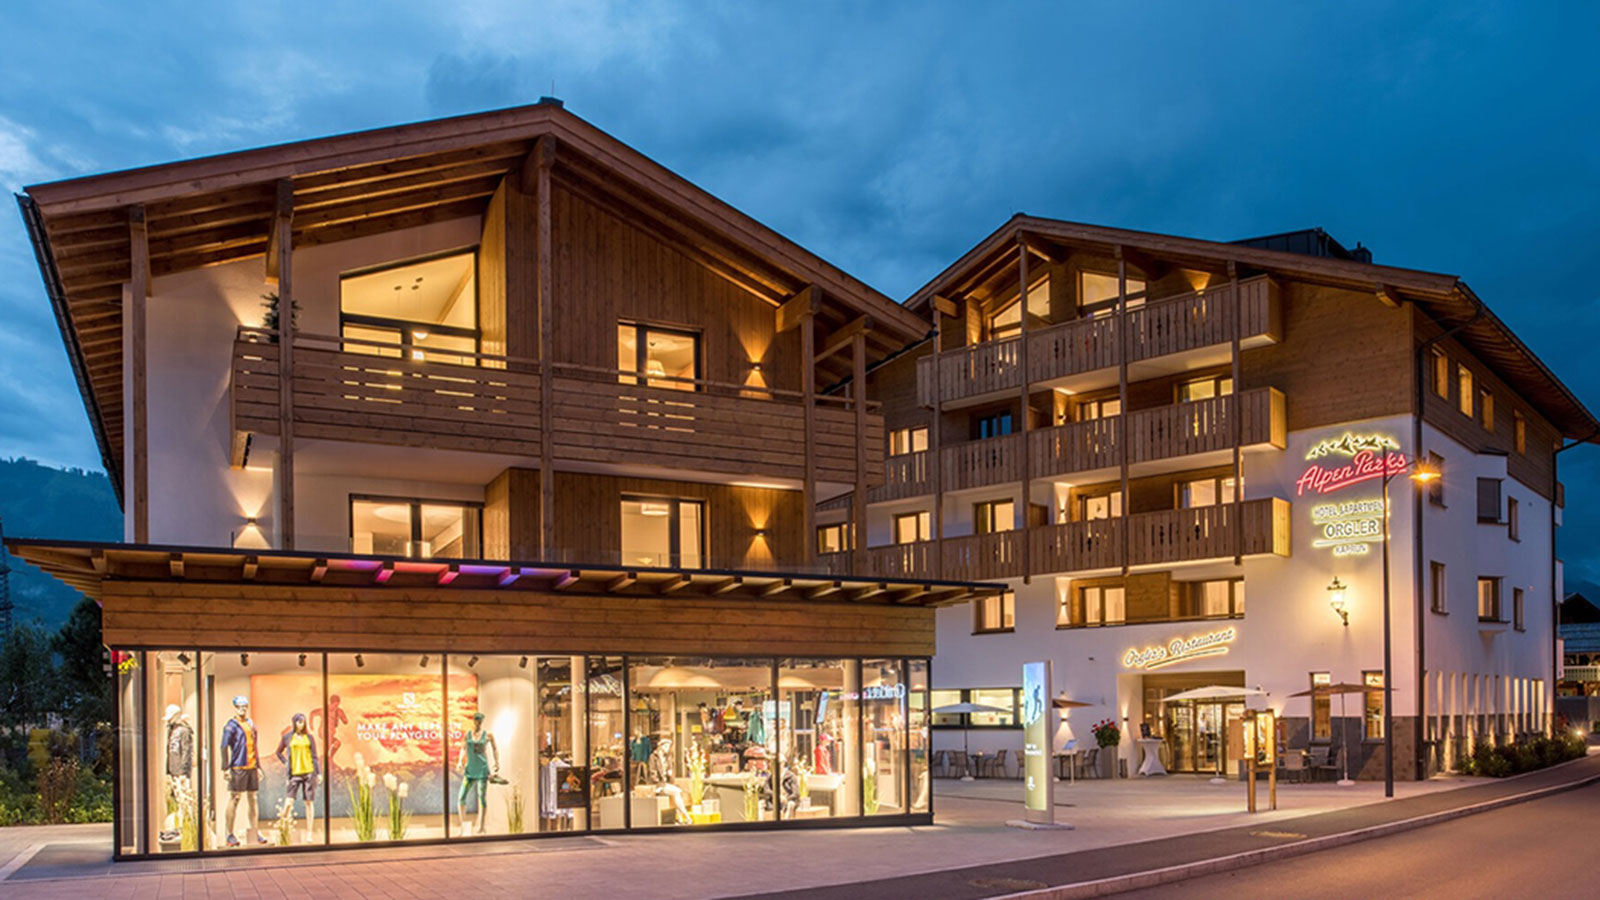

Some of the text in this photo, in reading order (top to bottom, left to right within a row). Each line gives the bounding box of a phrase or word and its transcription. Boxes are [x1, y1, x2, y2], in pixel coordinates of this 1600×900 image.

[1297, 450, 1407, 496] Alpen Parks
[1313, 505, 1338, 518] HOTEL
[1325, 519, 1379, 538] ORGLER
[1168, 627, 1235, 656] Restaurant
[357, 720, 462, 731] MAKE ANY TERRIN
[357, 731, 386, 741] YOUR
